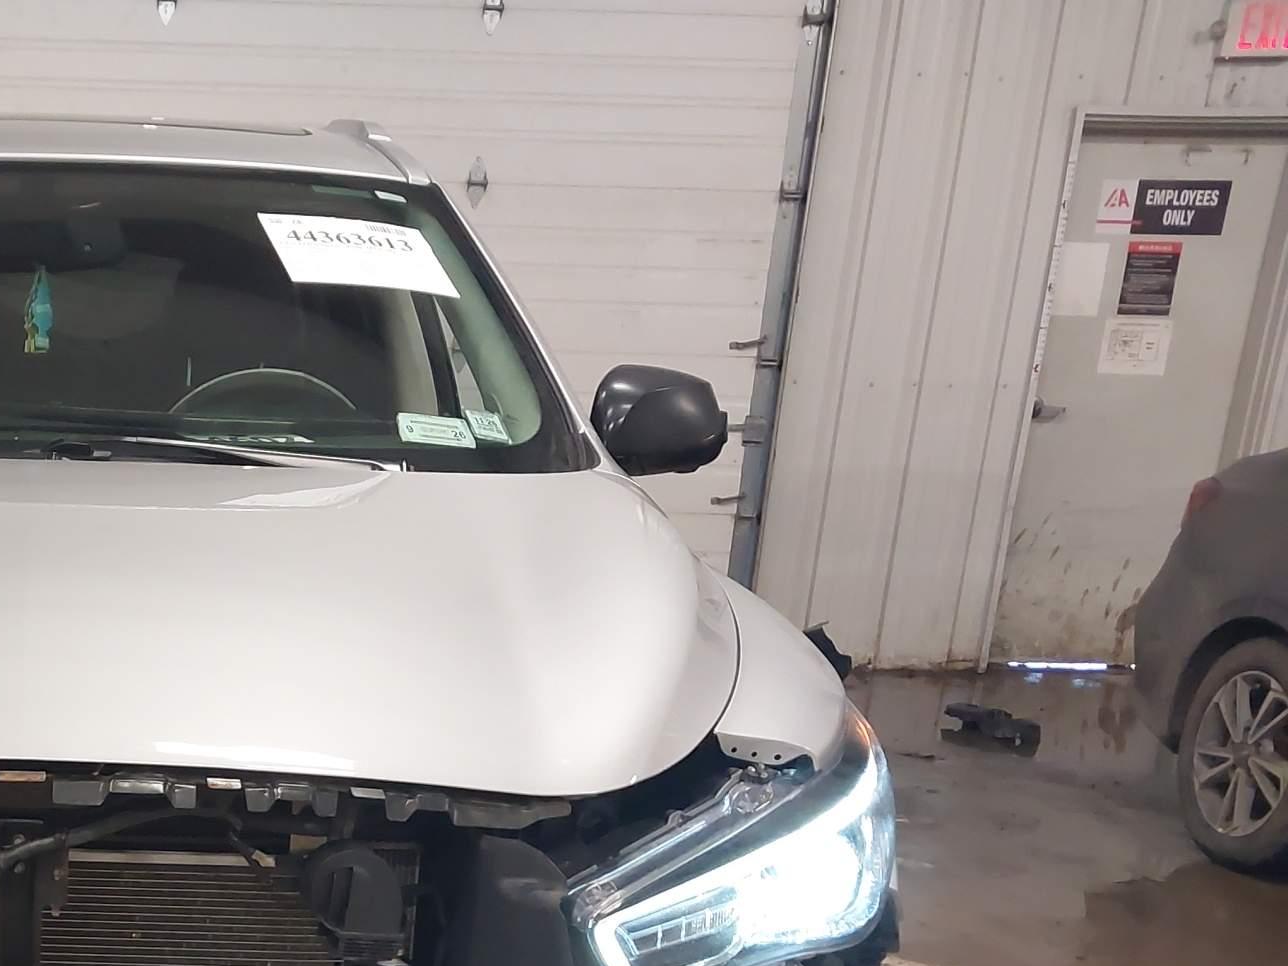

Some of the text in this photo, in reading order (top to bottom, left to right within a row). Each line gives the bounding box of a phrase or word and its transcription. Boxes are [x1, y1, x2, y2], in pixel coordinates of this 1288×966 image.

[1145, 189, 1220, 206] EMPLOYEES
[1162, 209, 1195, 226] ONLY
[287, 229, 414, 251] 44363613
